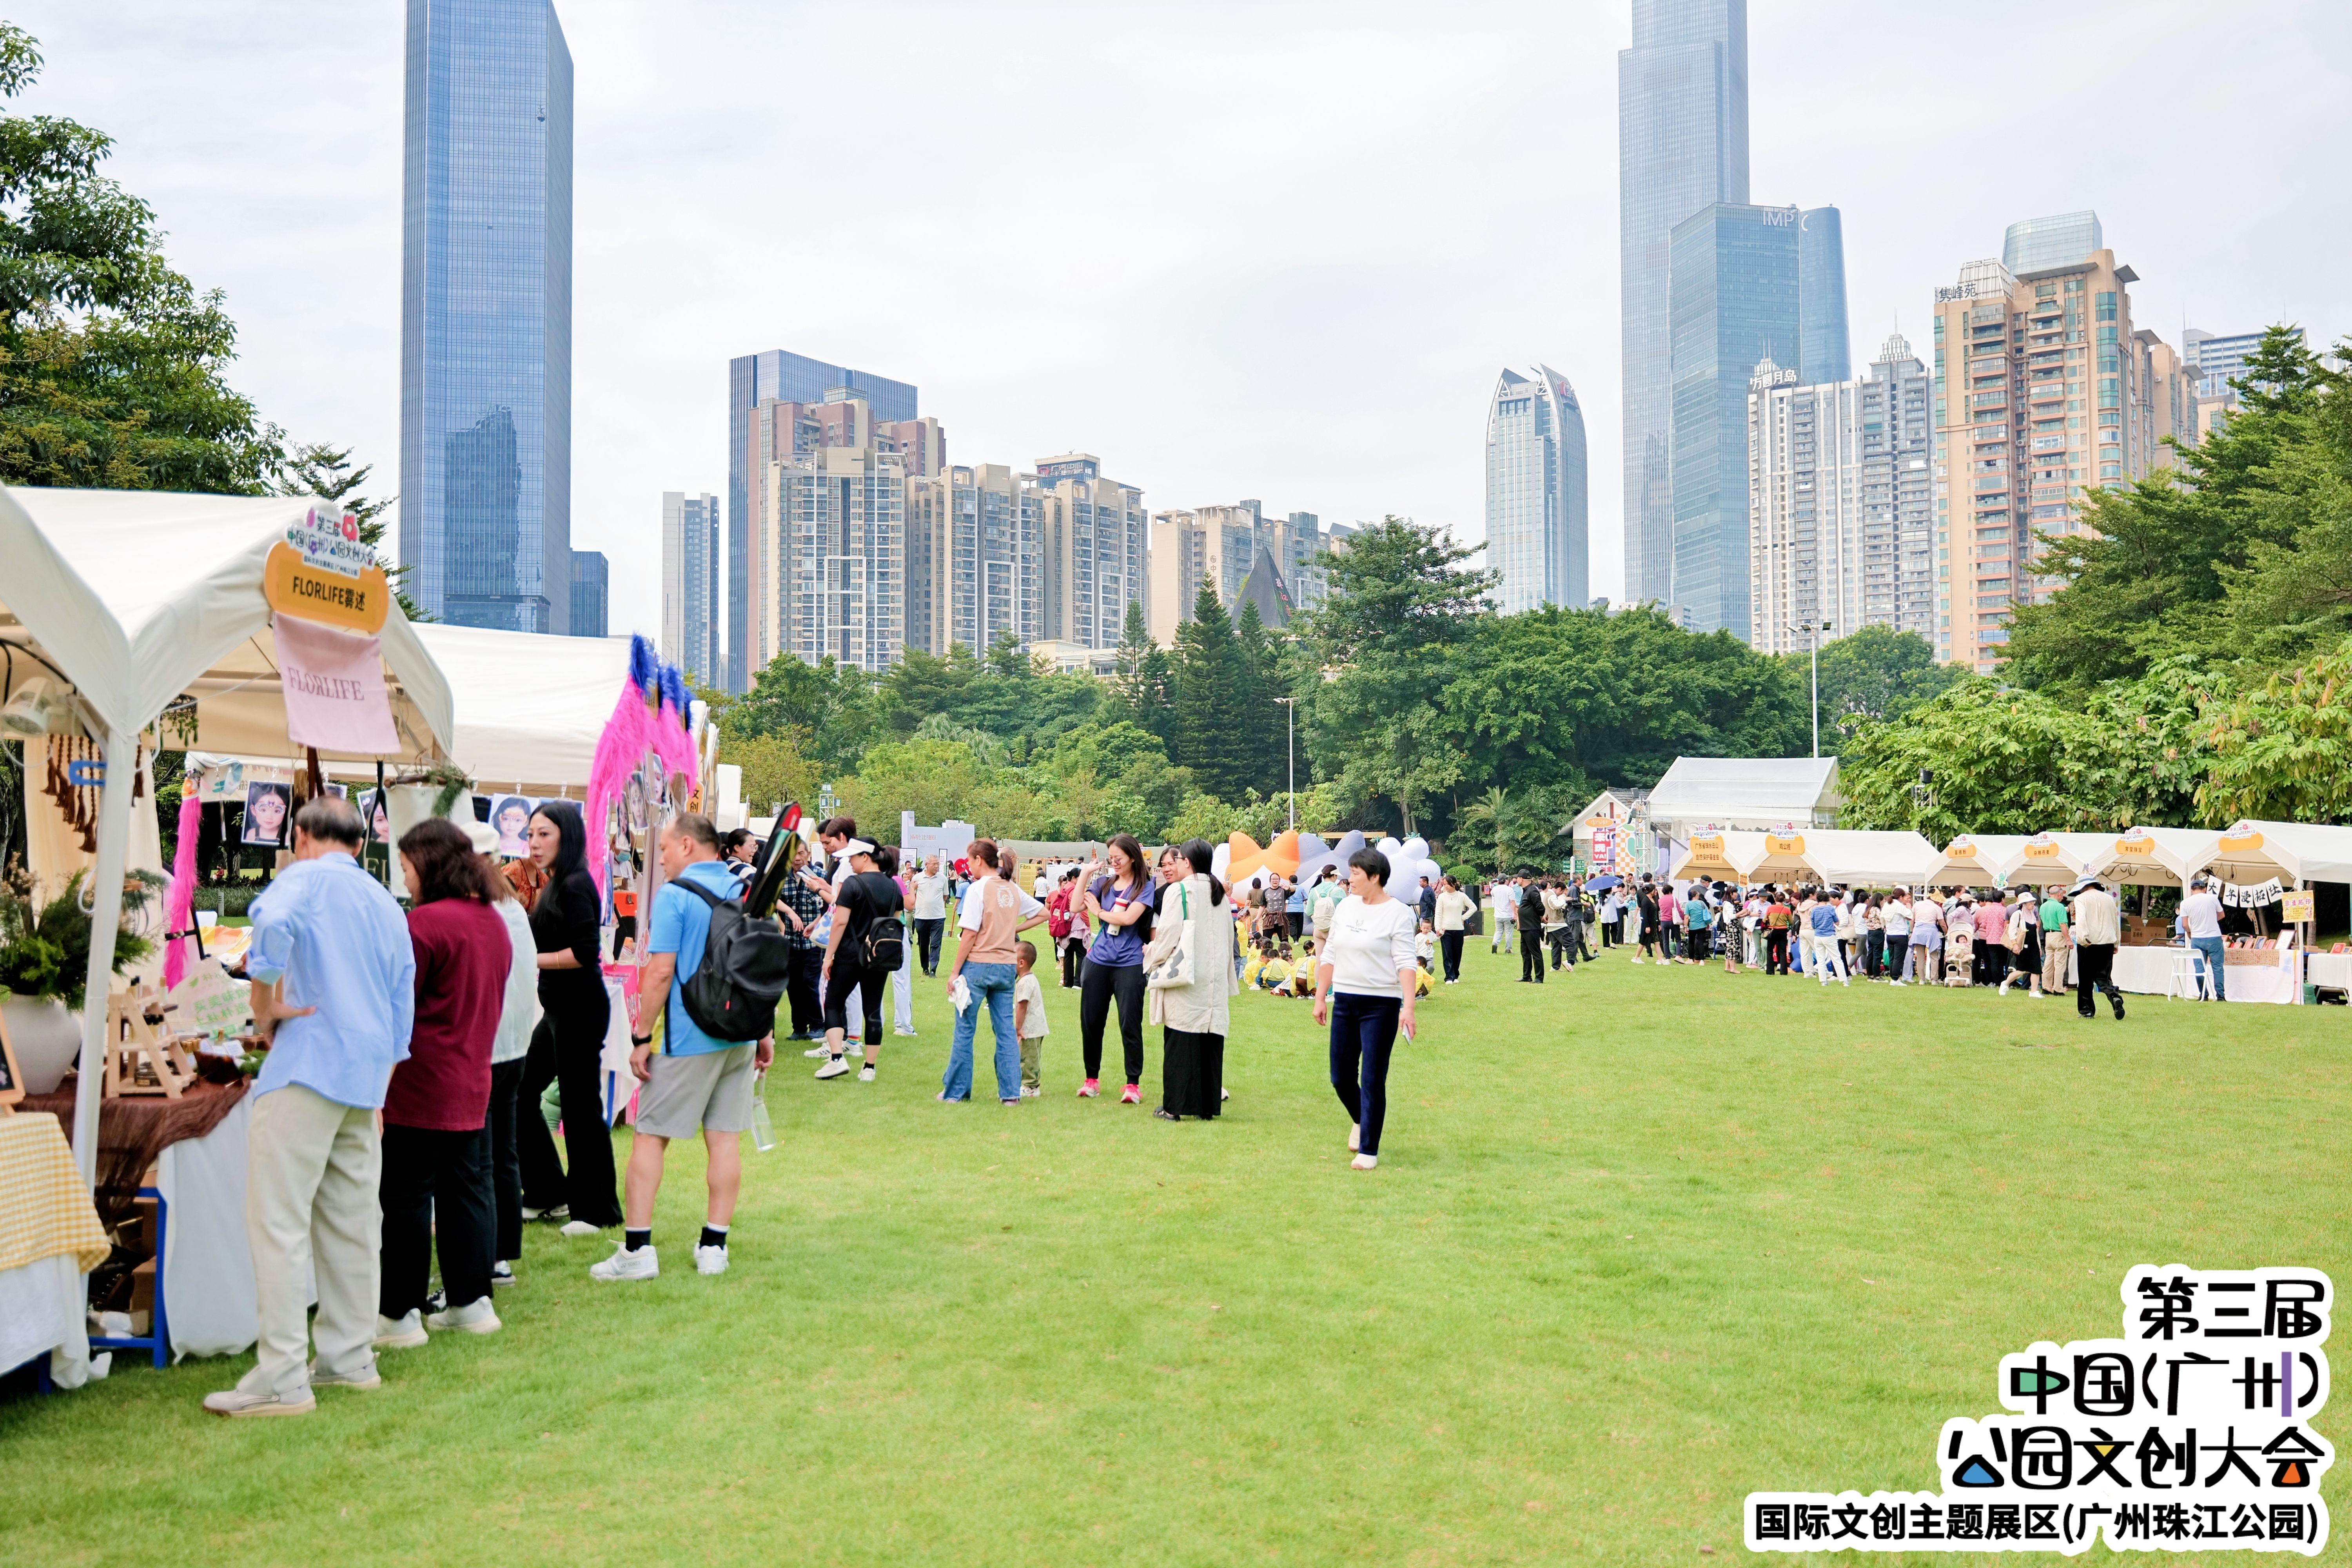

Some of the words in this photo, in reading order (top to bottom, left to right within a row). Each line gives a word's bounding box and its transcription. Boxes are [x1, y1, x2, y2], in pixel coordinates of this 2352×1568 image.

[1763, 211, 1794, 227] IMP
[1939, 283, 1976, 303] 隽峰苑
[1752, 369, 1796, 391] 方圆月岛
[317, 515, 341, 537] 第三届
[288, 666, 365, 701] FLORLIFE
[690, 788, 700, 812] 文创
[1594, 833, 1606, 853] 来玩
